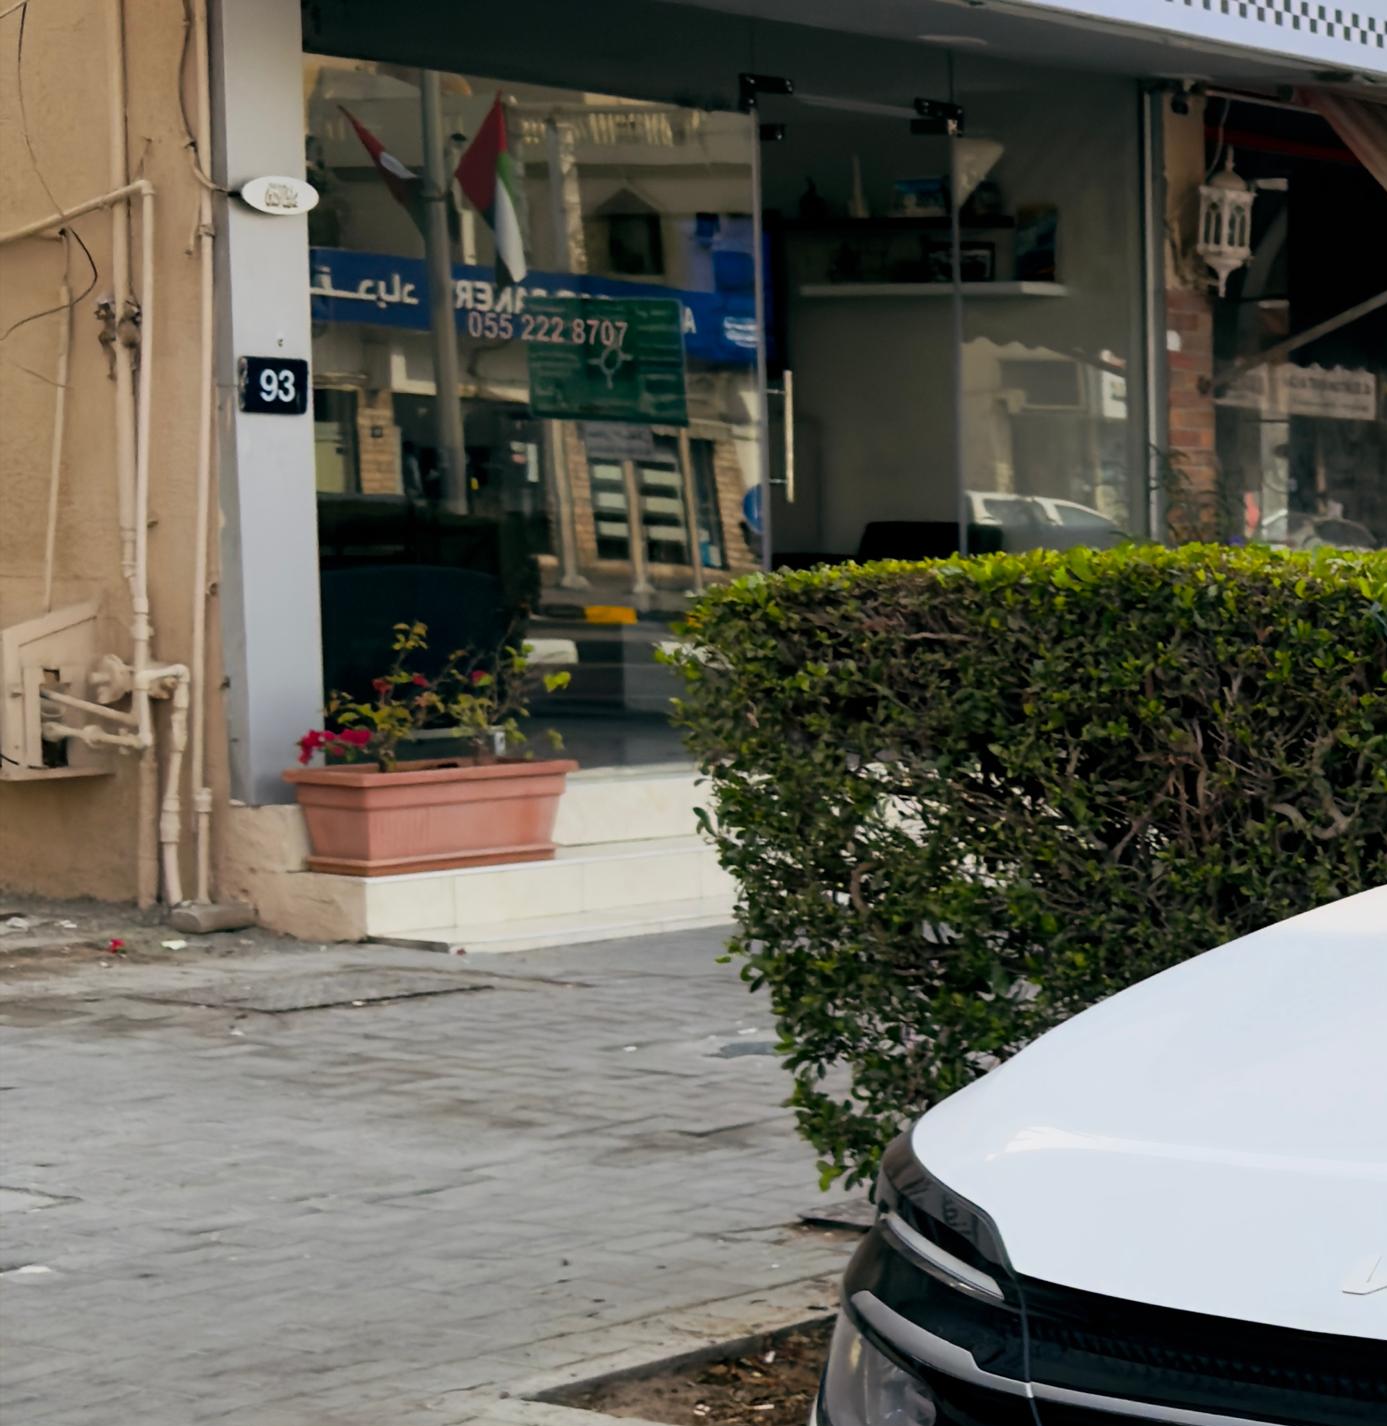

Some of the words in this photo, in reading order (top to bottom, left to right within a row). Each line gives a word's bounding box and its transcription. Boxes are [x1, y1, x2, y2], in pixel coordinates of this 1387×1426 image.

[467, 310, 513, 340] 055
[520, 315, 565, 344] 222
[571, 318, 629, 347] 8707
[259, 368, 296, 403] 93
